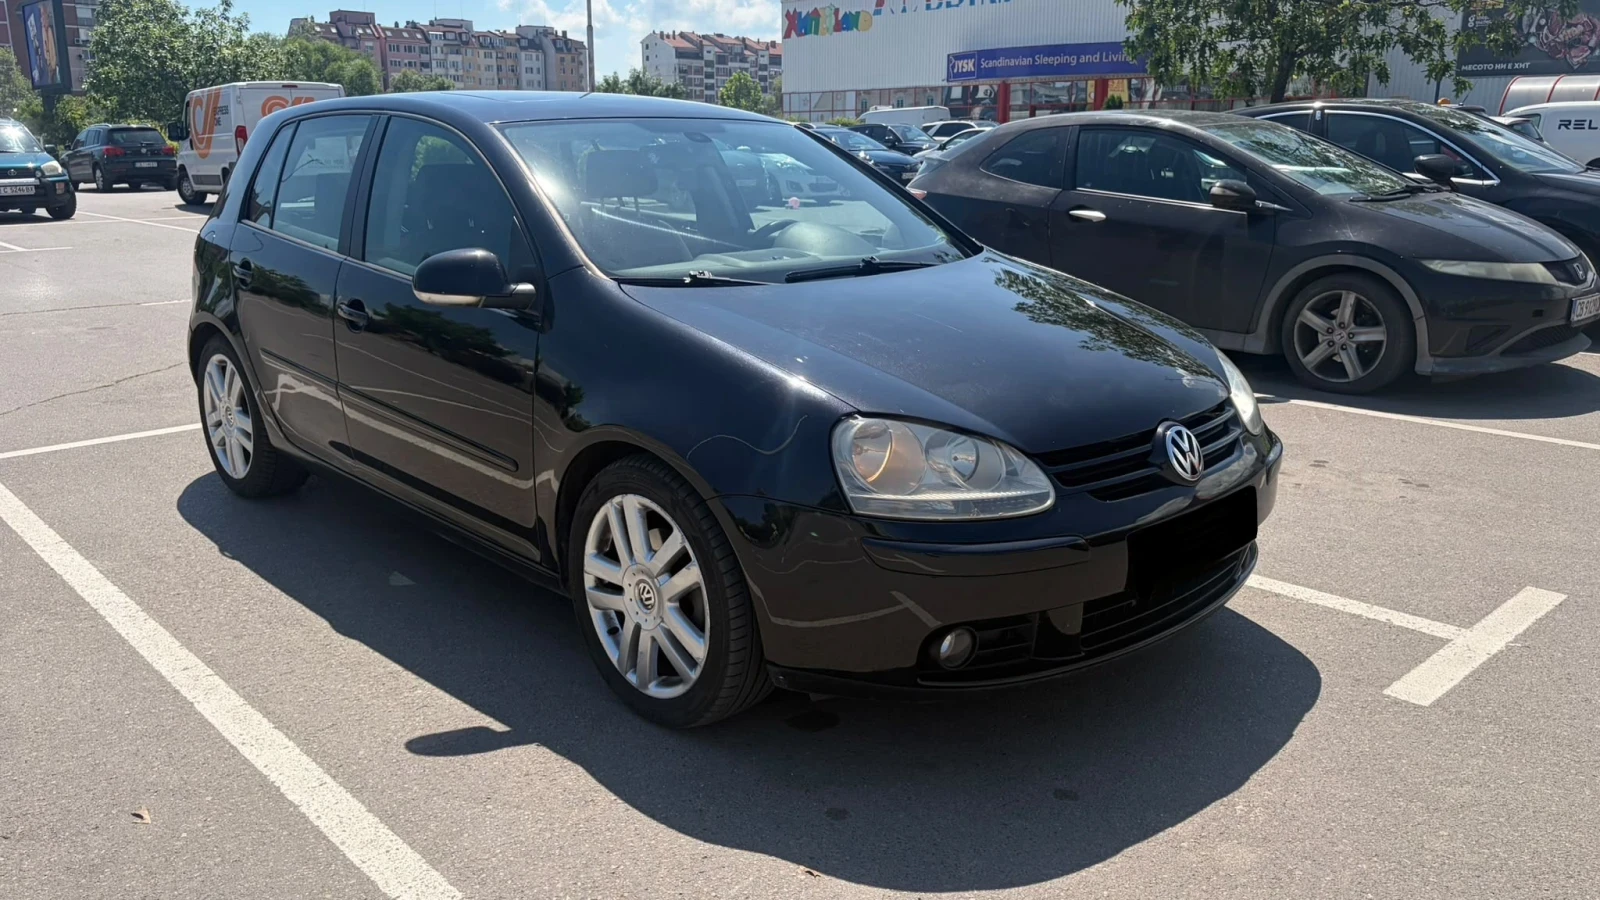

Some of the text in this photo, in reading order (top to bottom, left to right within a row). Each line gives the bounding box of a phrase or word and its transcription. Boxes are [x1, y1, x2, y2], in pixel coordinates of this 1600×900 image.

[954, 58, 975, 73] JYSK
[980, 56, 1033, 68] Scandinavian
[1034, 53, 1077, 67] Sleeping
[1079, 51, 1100, 63] and
[1461, 63, 1494, 71] МЕСОТО
[1507, 62, 1513, 70] Е
[1558, 119, 1600, 130] REL
